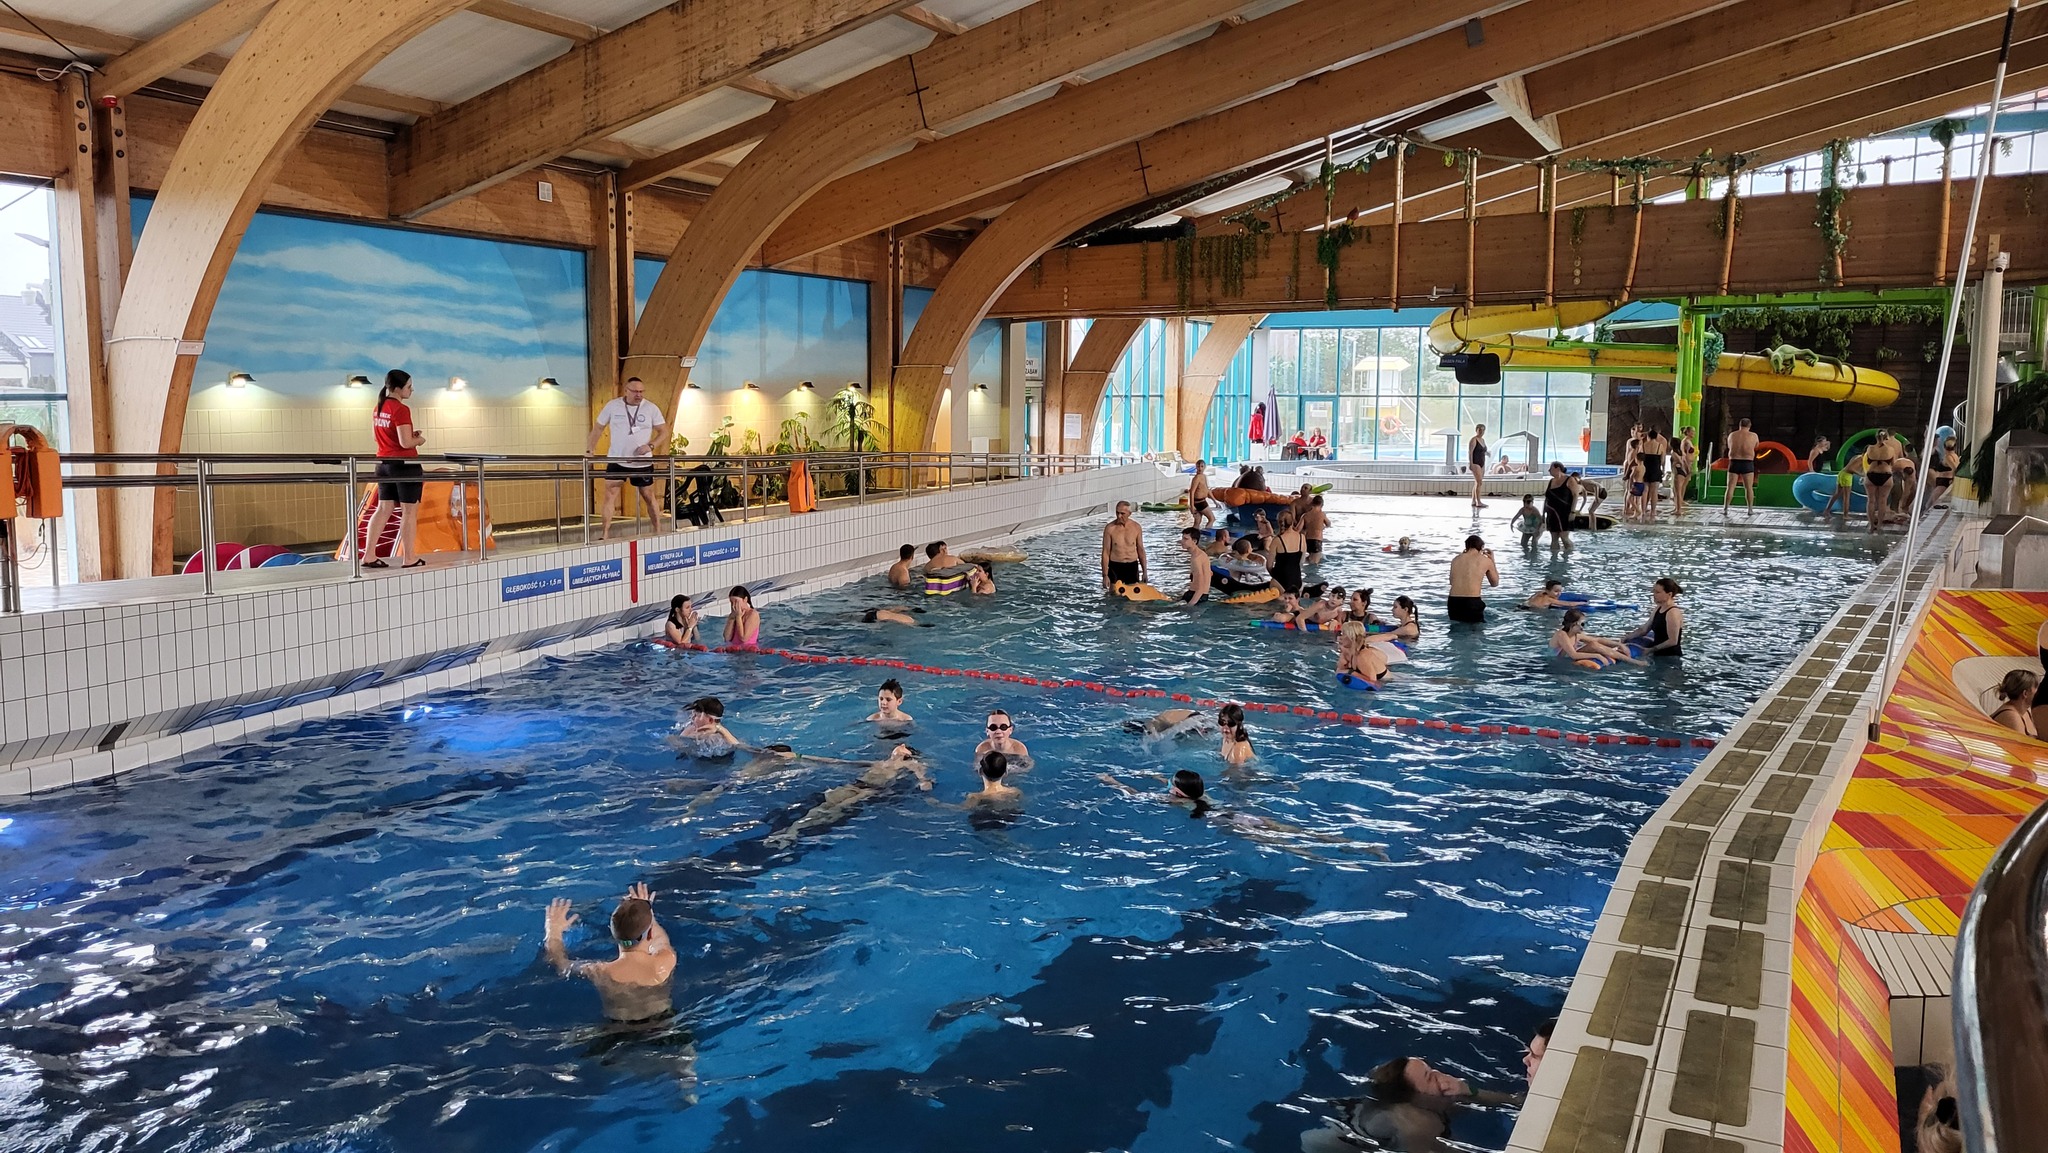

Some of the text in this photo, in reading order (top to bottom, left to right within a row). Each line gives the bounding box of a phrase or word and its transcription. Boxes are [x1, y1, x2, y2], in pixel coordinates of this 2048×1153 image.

[583, 566, 600, 574] STREFA
[572, 570, 620, 585] UMIEJĄCYCH PŁYWAĆ
[506, 582, 538, 594] GŁĘBOKOŚĆ
